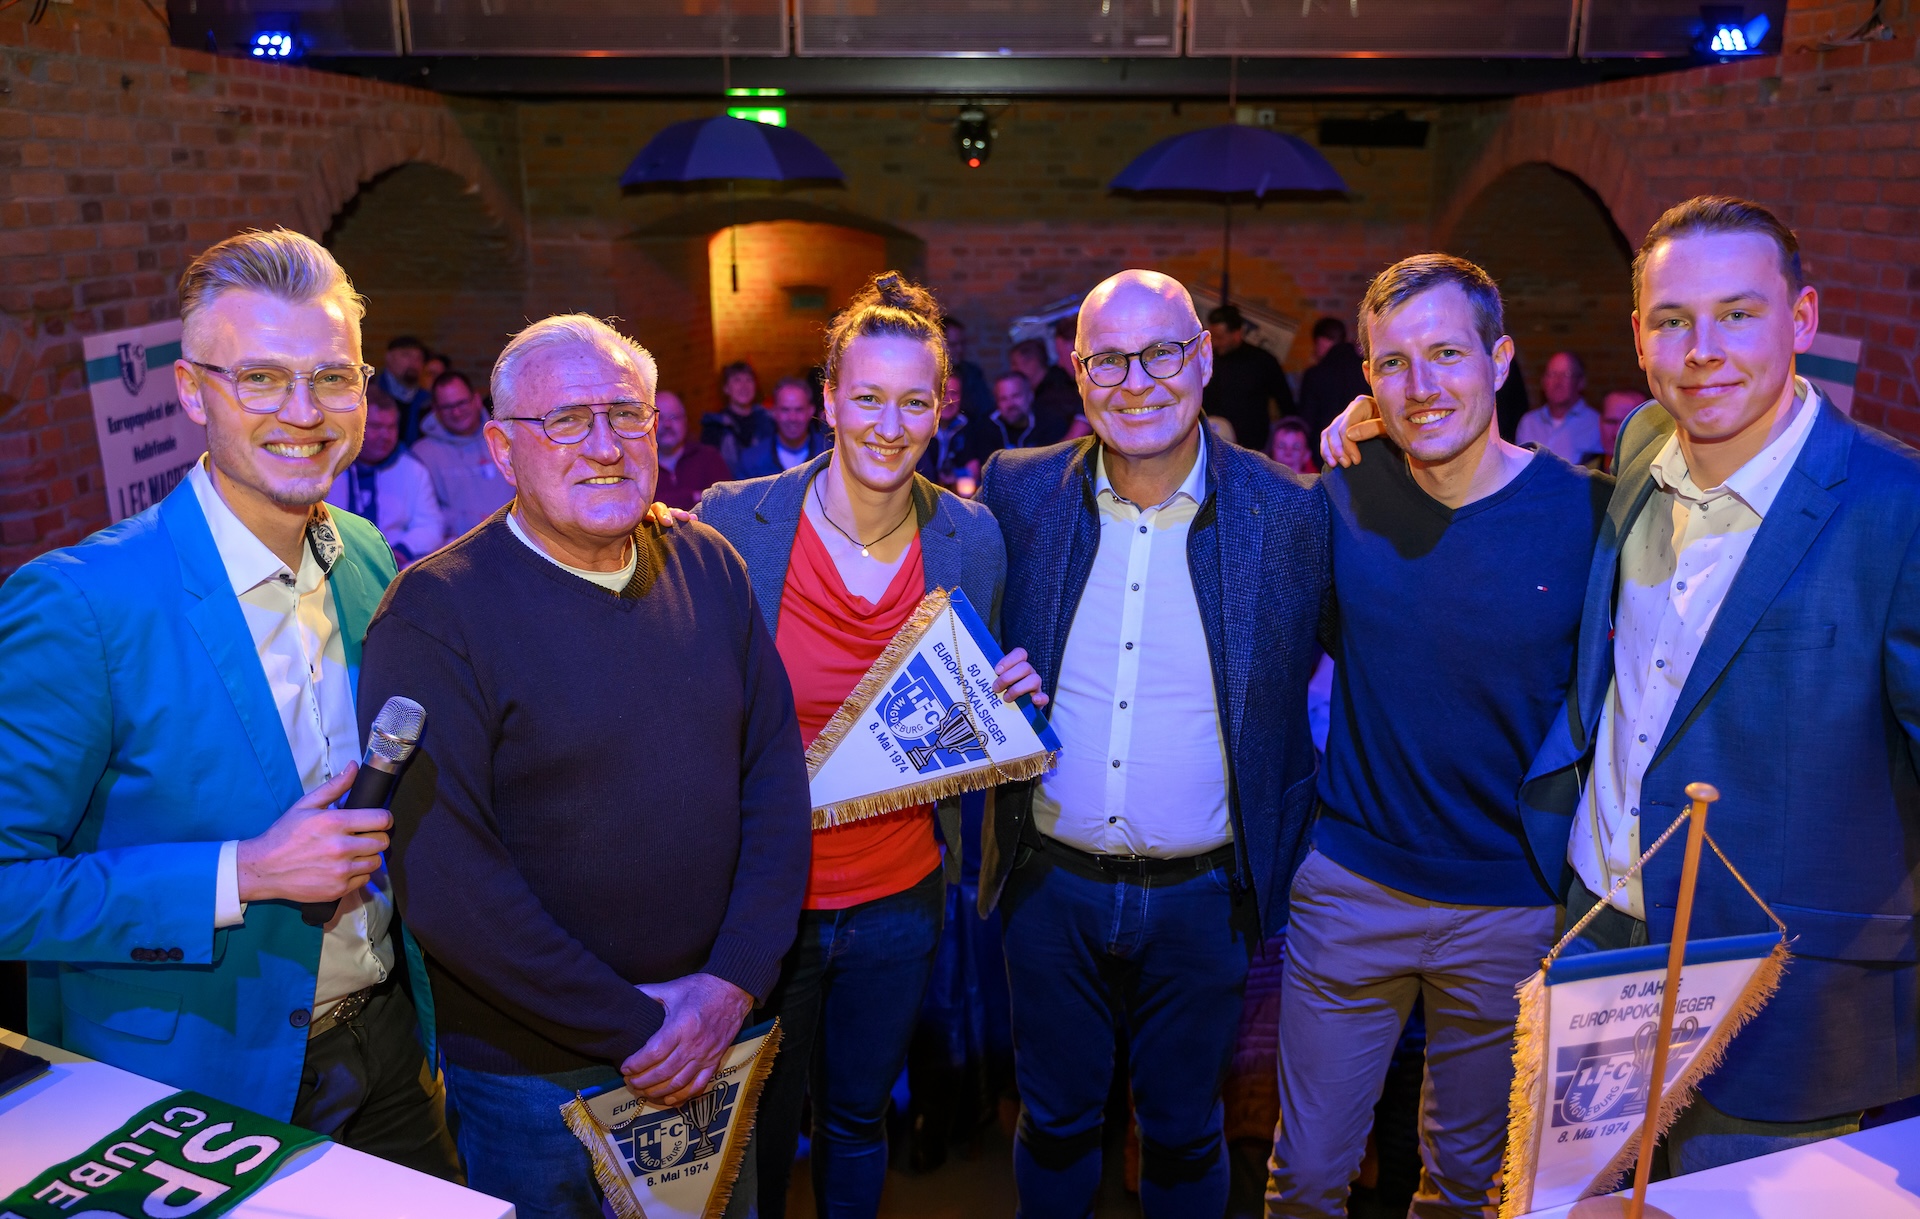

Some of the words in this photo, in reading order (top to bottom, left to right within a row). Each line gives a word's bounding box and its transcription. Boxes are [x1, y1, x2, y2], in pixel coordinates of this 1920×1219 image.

[107, 404, 163, 435] Europapokal
[165, 401, 178, 416] der
[133, 436, 177, 463] Halbfinale
[148, 460, 197, 503] MAGD
[932, 642, 1007, 746] EUROPAPOKALSIEGER
[967, 663, 981, 678] 50
[975, 678, 1003, 710] JAHRE
[890, 697, 924, 734] MAGDEBURG
[907, 685, 940, 725] 1.FC
[869, 722, 880, 734] 8.
[876, 732, 894, 752] Mai
[889, 750, 909, 774] 1974
[1620, 984, 1637, 1000] 50
[1637, 977, 1684, 998] JAH
[1569, 996, 1715, 1030] EUROPAPOKAIEGER
[1577, 1061, 1632, 1087] 1.FC
[1569, 1085, 1620, 1118] MAGDEBURG
[638, 1122, 684, 1148] 1.FC
[1557, 1130, 1569, 1143] 8.
[1572, 1126, 1599, 1141] Mai
[1600, 1120, 1631, 1137] 1974
[32, 1106, 208, 1210] CLUBE
[640, 1140, 683, 1168] MAGDEBURG
[647, 1177, 657, 1187] 8.
[661, 1169, 680, 1184] Mai
[683, 1161, 709, 1177] 1974
